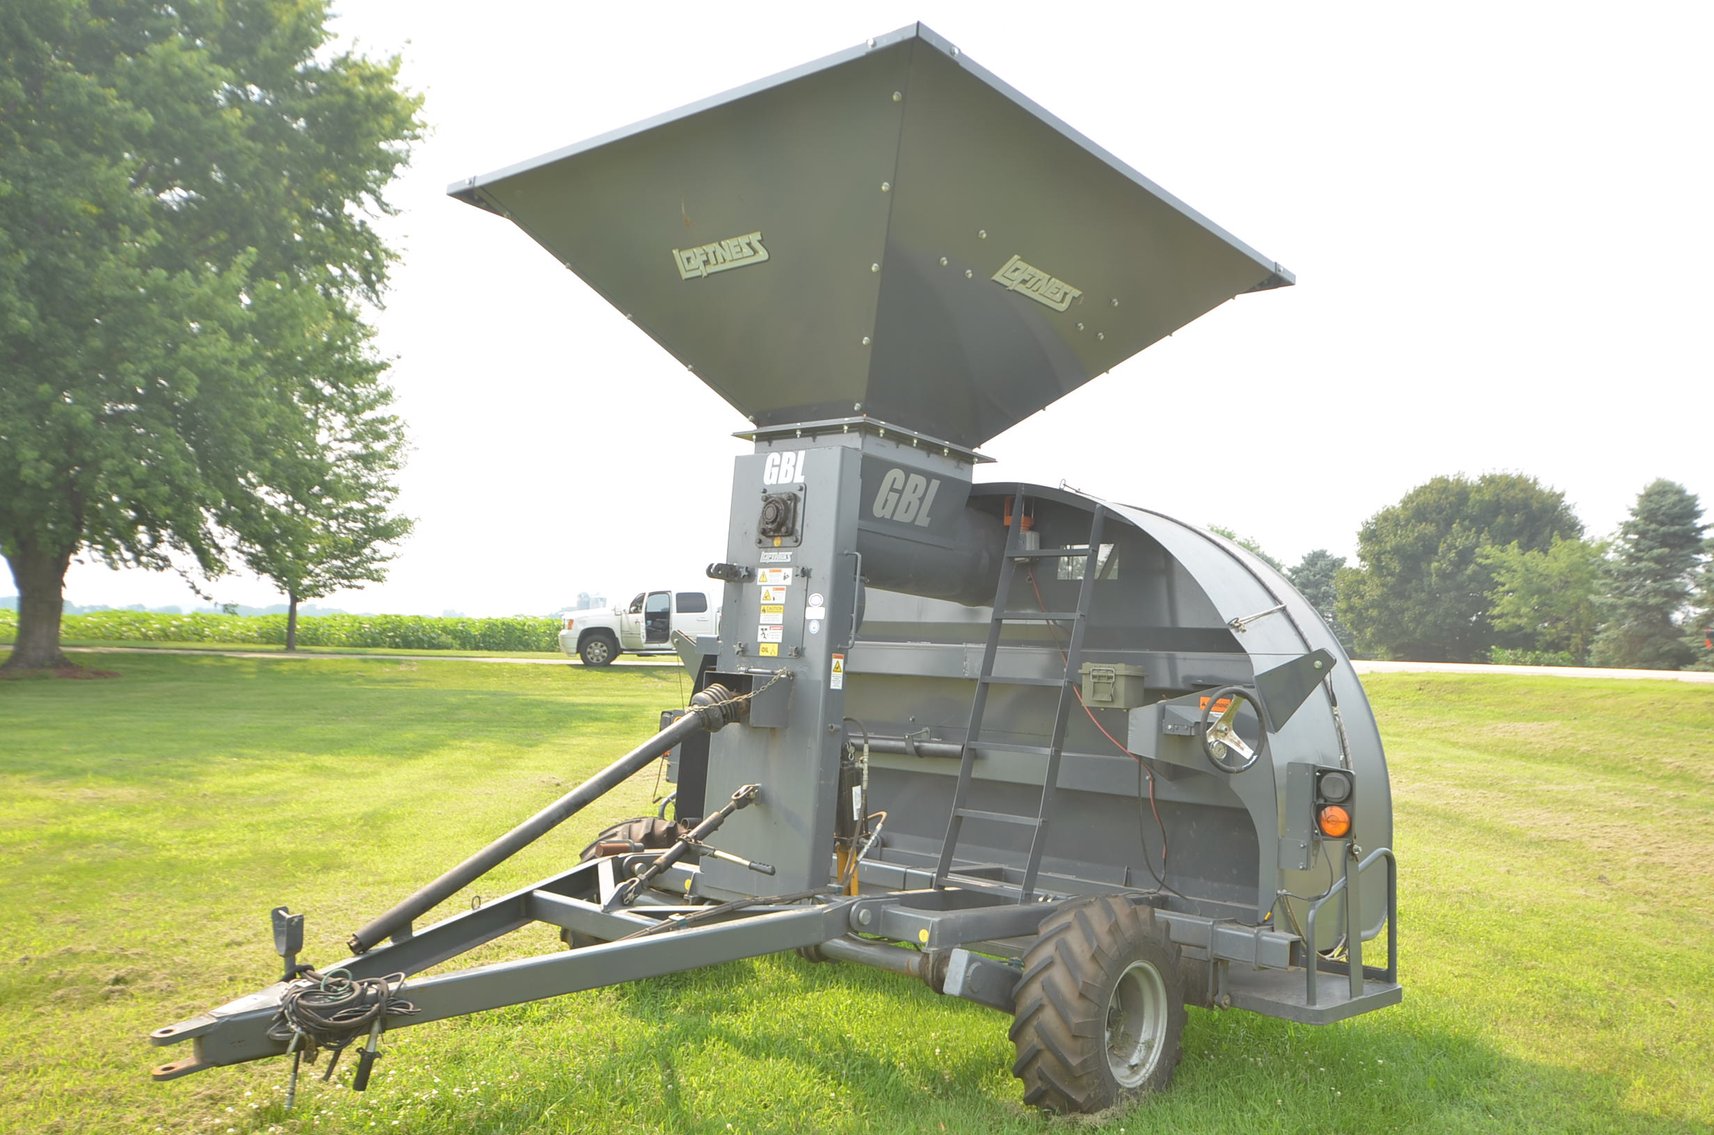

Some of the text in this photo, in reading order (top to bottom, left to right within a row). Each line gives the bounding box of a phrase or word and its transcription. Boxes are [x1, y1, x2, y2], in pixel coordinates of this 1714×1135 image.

[672, 231, 769, 280] LOFTNESS
[991, 254, 1082, 312] LOFTNESS
[763, 450, 806, 485] GBL
[873, 468, 941, 527] GBL
